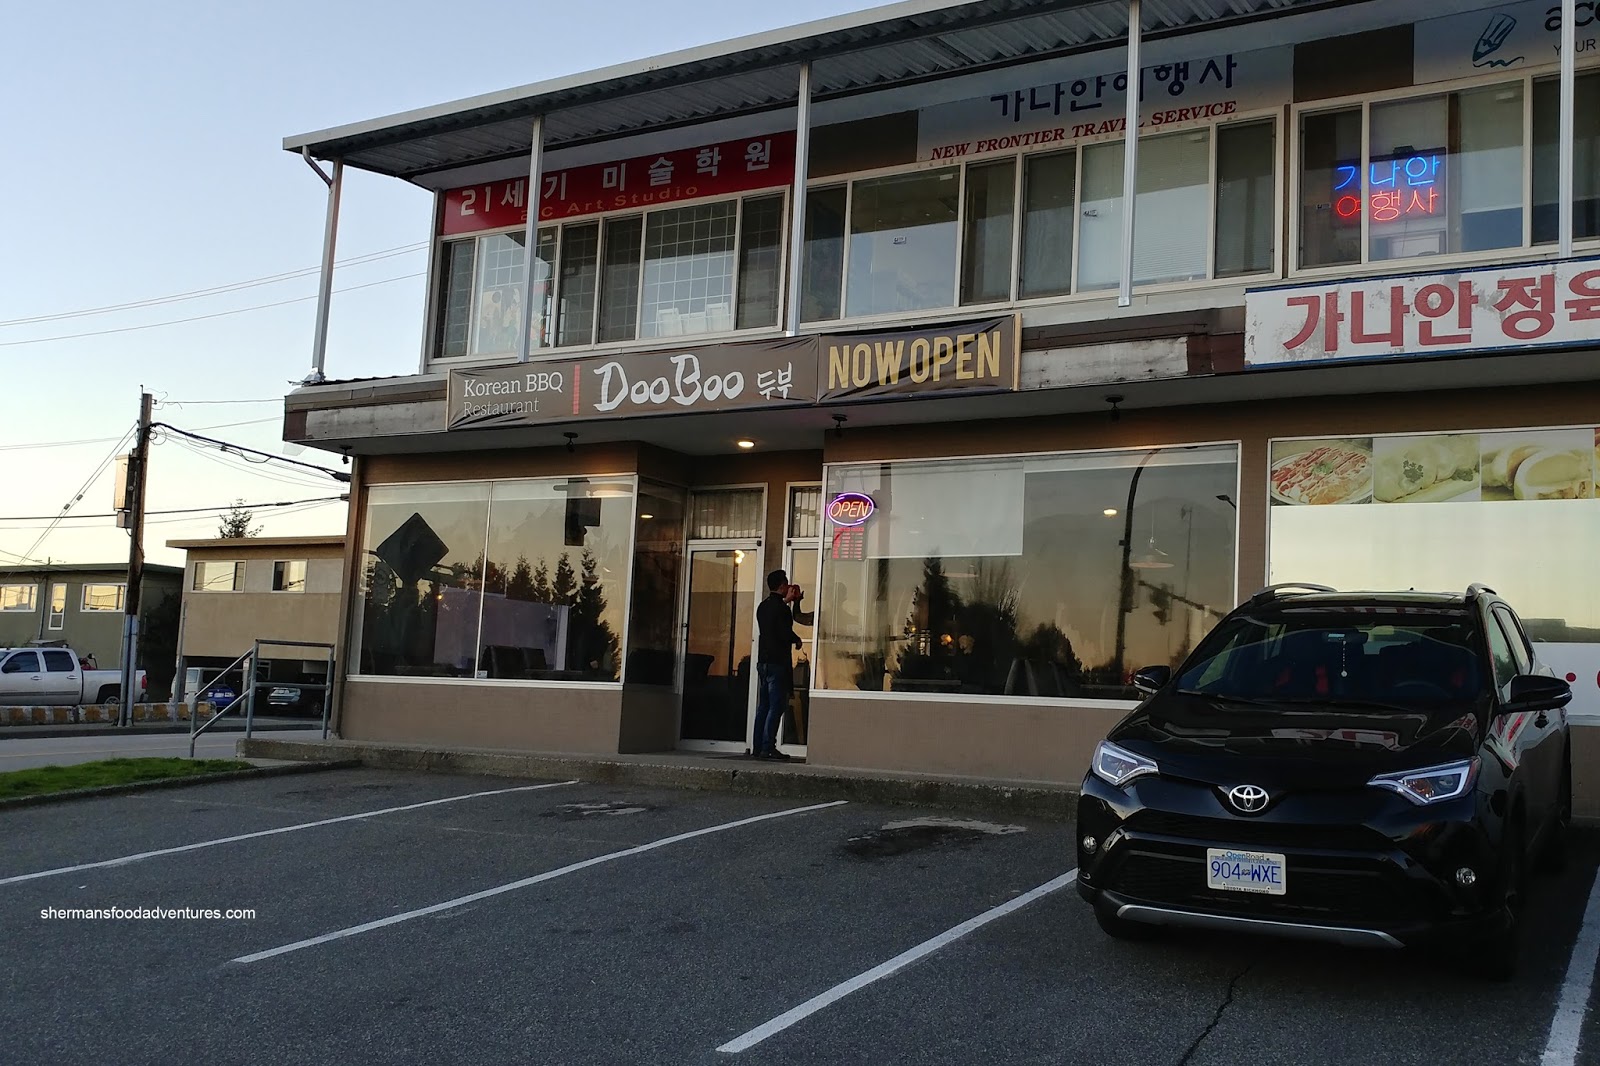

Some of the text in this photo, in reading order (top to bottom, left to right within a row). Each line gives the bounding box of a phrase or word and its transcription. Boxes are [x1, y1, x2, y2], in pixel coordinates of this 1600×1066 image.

[1544, 1, 1600, 31] ac
[1553, 38, 1596, 56] YUR
[930, 100, 1237, 161] NEW FRONTIER TRAV SERVICE
[460, 172, 567, 216] 21세기
[519, 206, 554, 222] 2C
[614, 185, 698, 208] Studio
[828, 330, 1001, 390] NOW OPEN
[463, 371, 564, 398] Korean BBQ
[593, 353, 793, 412] DooBoo 두부
[463, 398, 540, 418] Restaurant
[830, 501, 869, 518] OPEN
[1211, 860, 1241, 880] 904
[1251, 863, 1281, 884] WXE
